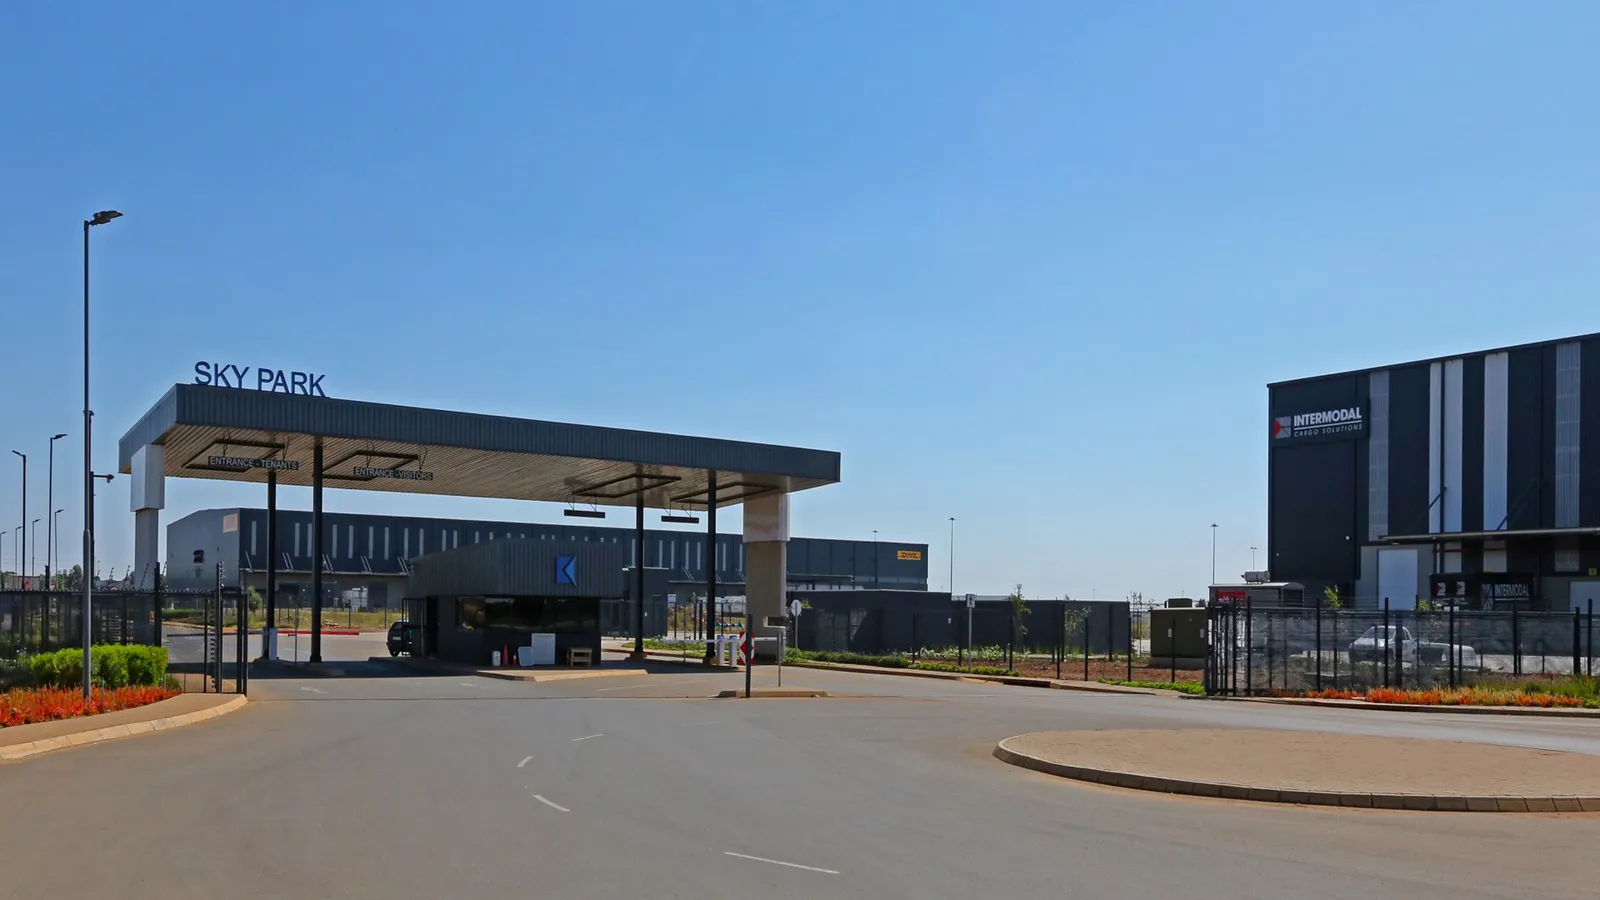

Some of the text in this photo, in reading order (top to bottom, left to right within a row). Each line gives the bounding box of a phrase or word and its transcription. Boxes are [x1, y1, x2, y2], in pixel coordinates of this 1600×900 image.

[195, 361, 326, 398] SKY PARK
[1294, 407, 1362, 426] INTERMODAL
[1294, 424, 1362, 438] CARGO SOLUTIONS
[210, 456, 254, 467] ENTRANCE
[261, 460, 297, 470] TENANTS
[355, 467, 394, 478] ENTRANCE
[399, 471, 433, 481] VISITORS
[1494, 583, 1530, 597] INTERMODAL
